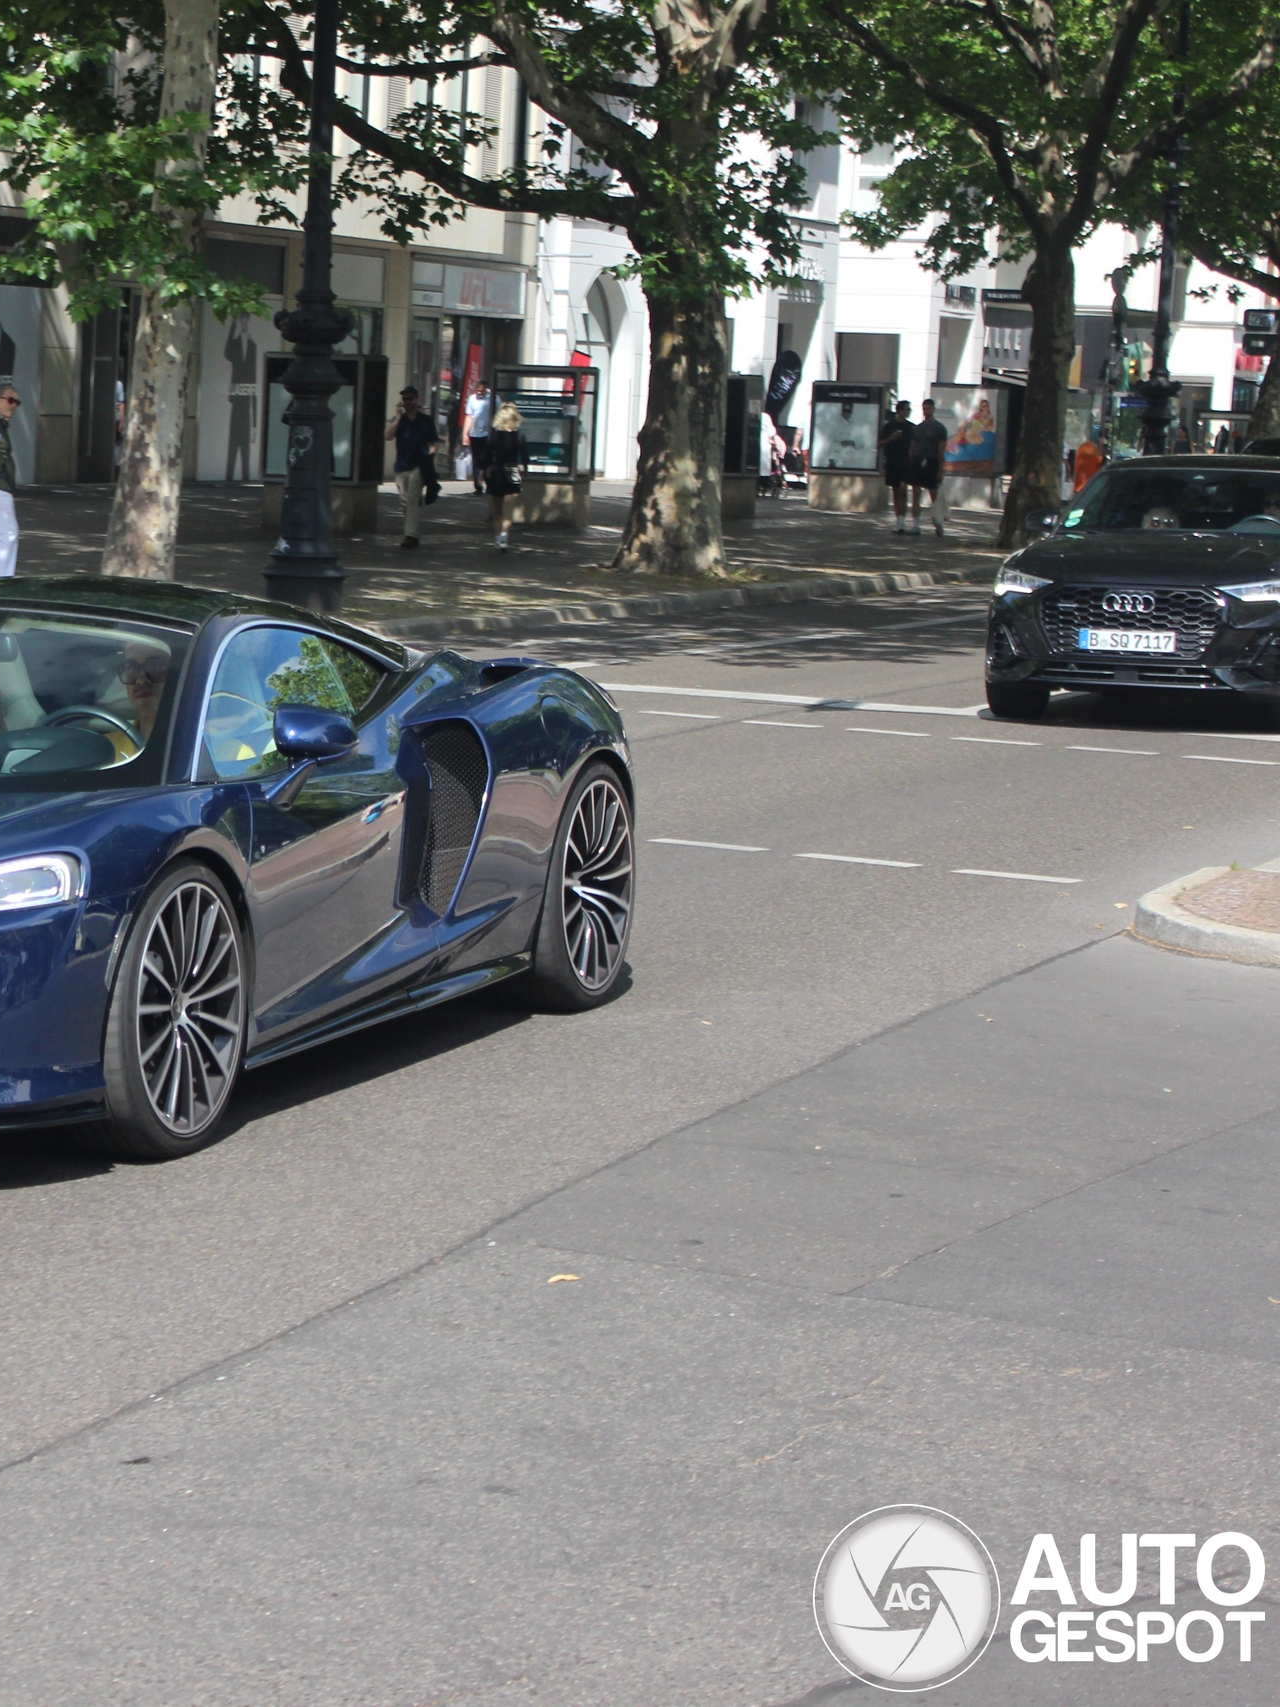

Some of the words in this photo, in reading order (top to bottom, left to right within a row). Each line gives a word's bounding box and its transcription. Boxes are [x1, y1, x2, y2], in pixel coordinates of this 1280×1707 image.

[1089, 632, 1099, 647] B
[1109, 633, 1129, 647] SQ
[1133, 635, 1174, 650] 7117
